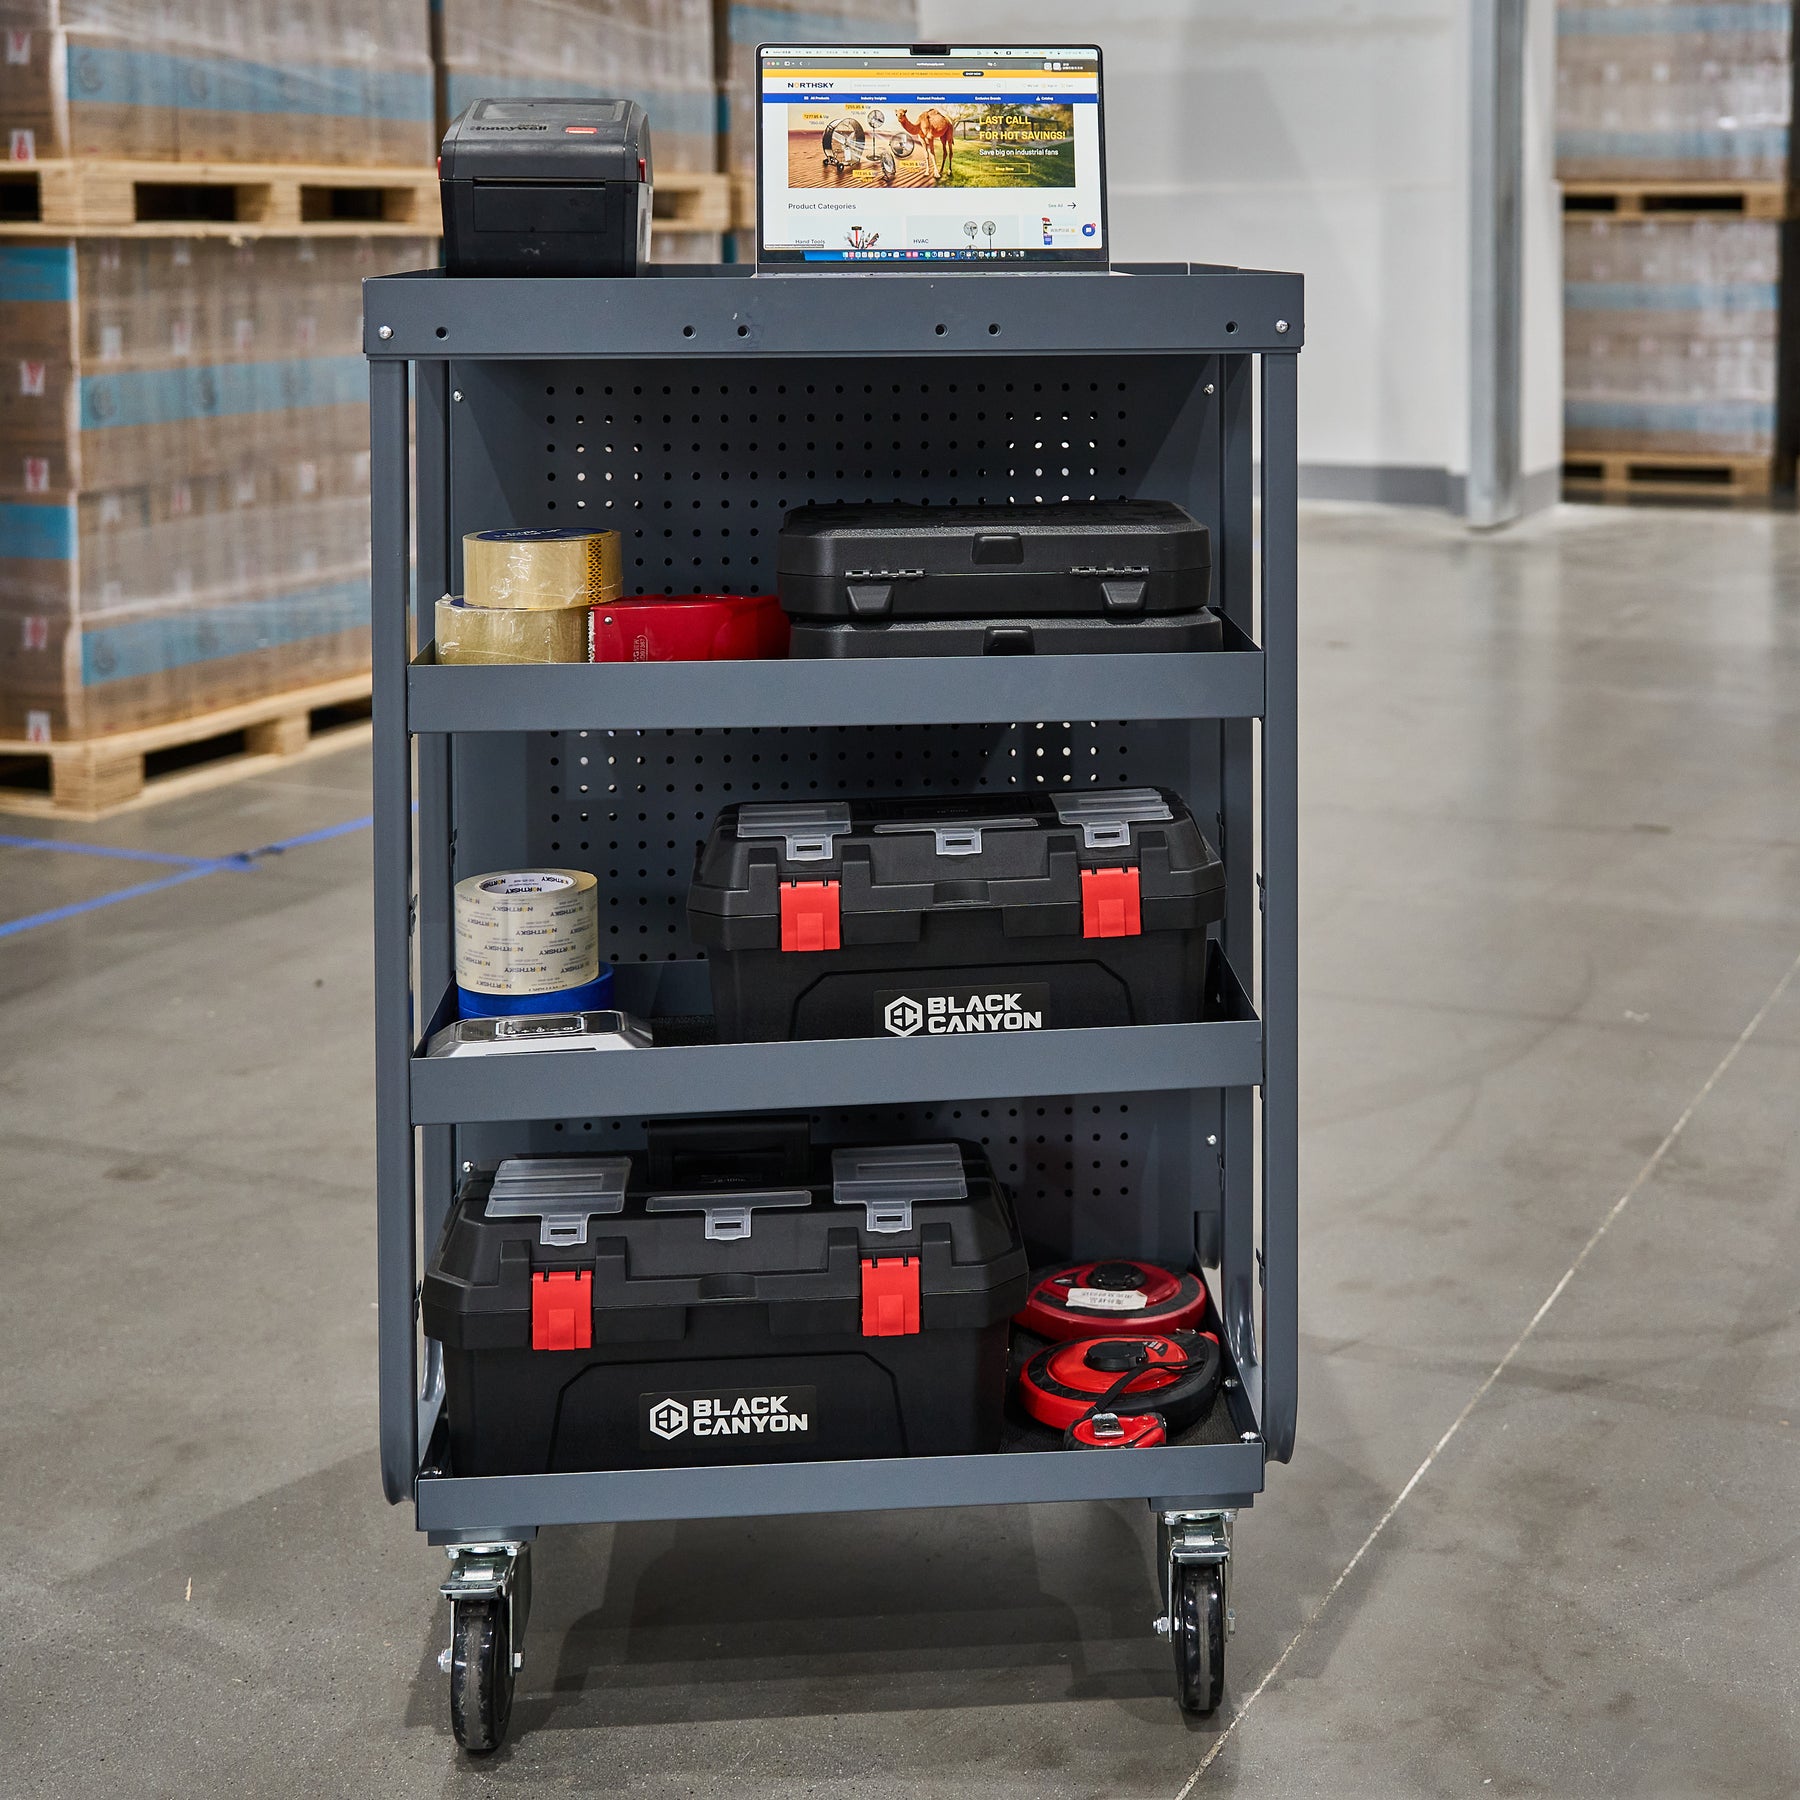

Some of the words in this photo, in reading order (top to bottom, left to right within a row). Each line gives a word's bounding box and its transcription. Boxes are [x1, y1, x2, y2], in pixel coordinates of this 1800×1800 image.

[980, 116, 1004, 125] LAST
[1005, 115, 1031, 124] CALL
[980, 131, 999, 140] FOR
[1001, 131, 1020, 140] HOT
[1021, 131, 1066, 140] SAVINGS!
[817, 203, 857, 211] Categories
[505, 887, 542, 895] NORTHSKY
[550, 906, 583, 917] NORTHSKY
[515, 928, 557, 936] NORTHSKY
[484, 945, 524, 953] NORTHSKY
[538, 944, 576, 956] NORTHSKY
[476, 980, 512, 989] NORTHSKY
[928, 993, 1022, 1014] BLACK
[928, 1011, 1042, 1034] CANYON
[693, 1396, 788, 1417] BLACK
[693, 1413, 808, 1436] CANYON
